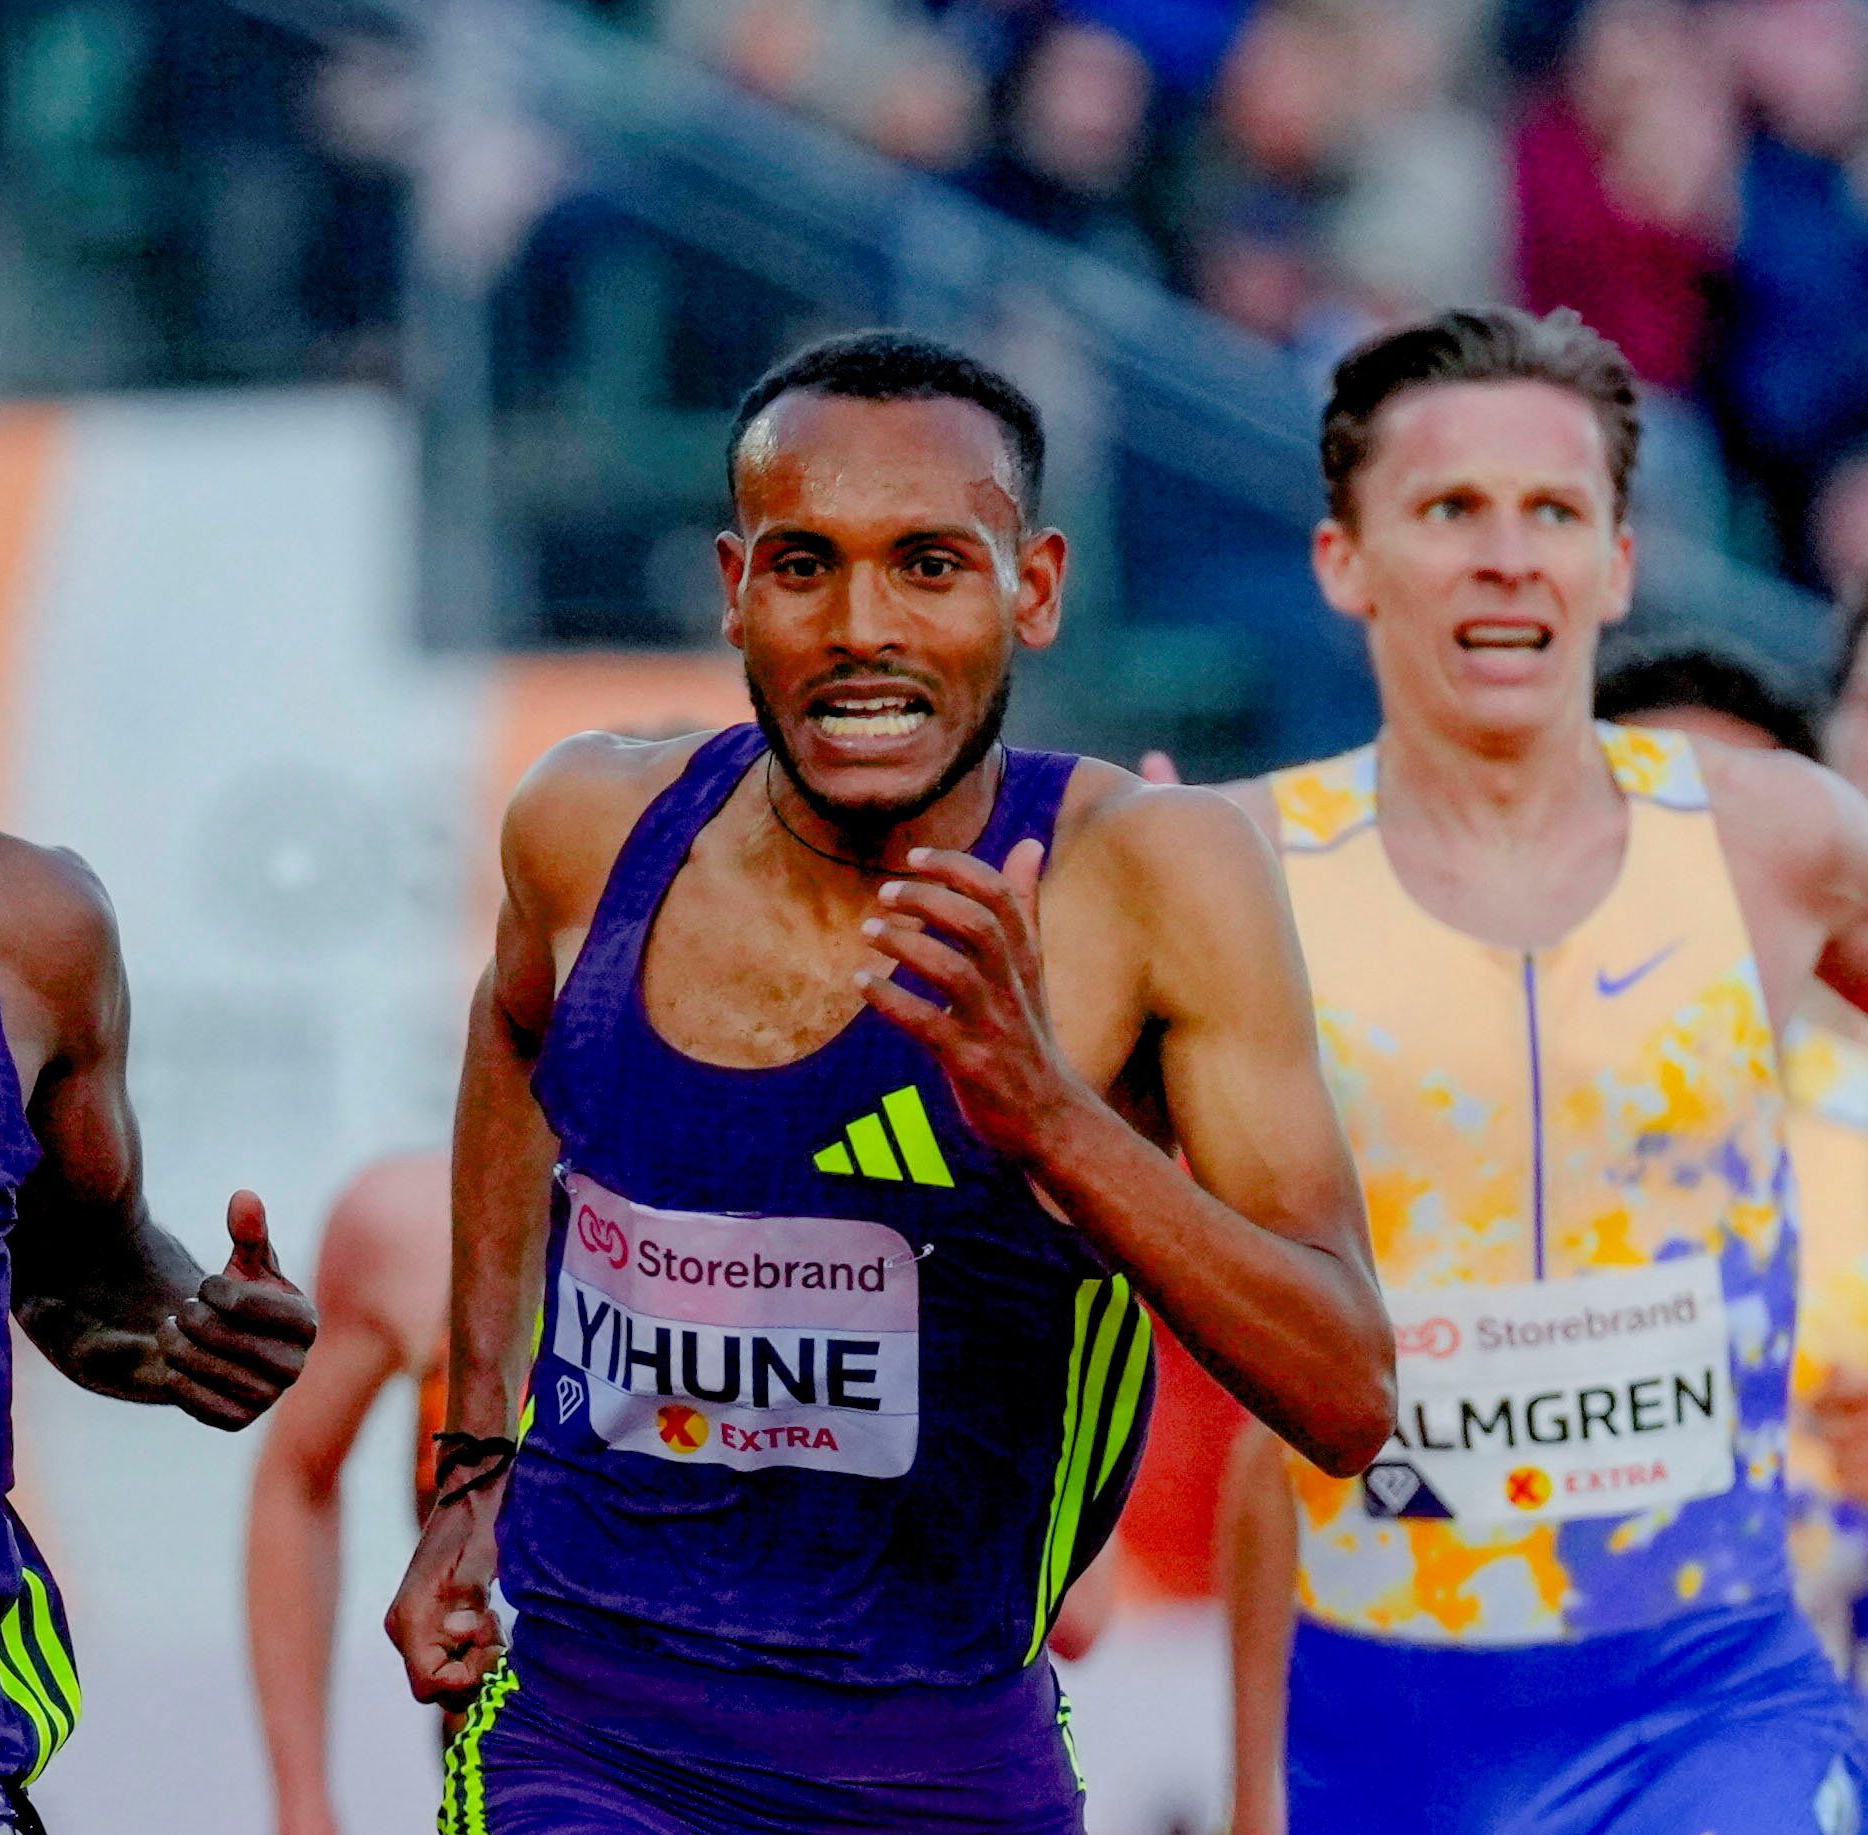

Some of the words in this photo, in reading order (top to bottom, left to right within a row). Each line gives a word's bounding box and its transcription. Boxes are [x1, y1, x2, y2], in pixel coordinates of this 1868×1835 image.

[637, 1240, 885, 1292] Storebrand
[1475, 1292, 1697, 1352] Storebrand
[576, 1289, 881, 1411] YIHUNE
[721, 1422, 839, 1452] EXTRA
[1564, 1461, 1668, 1495] EXTRA
